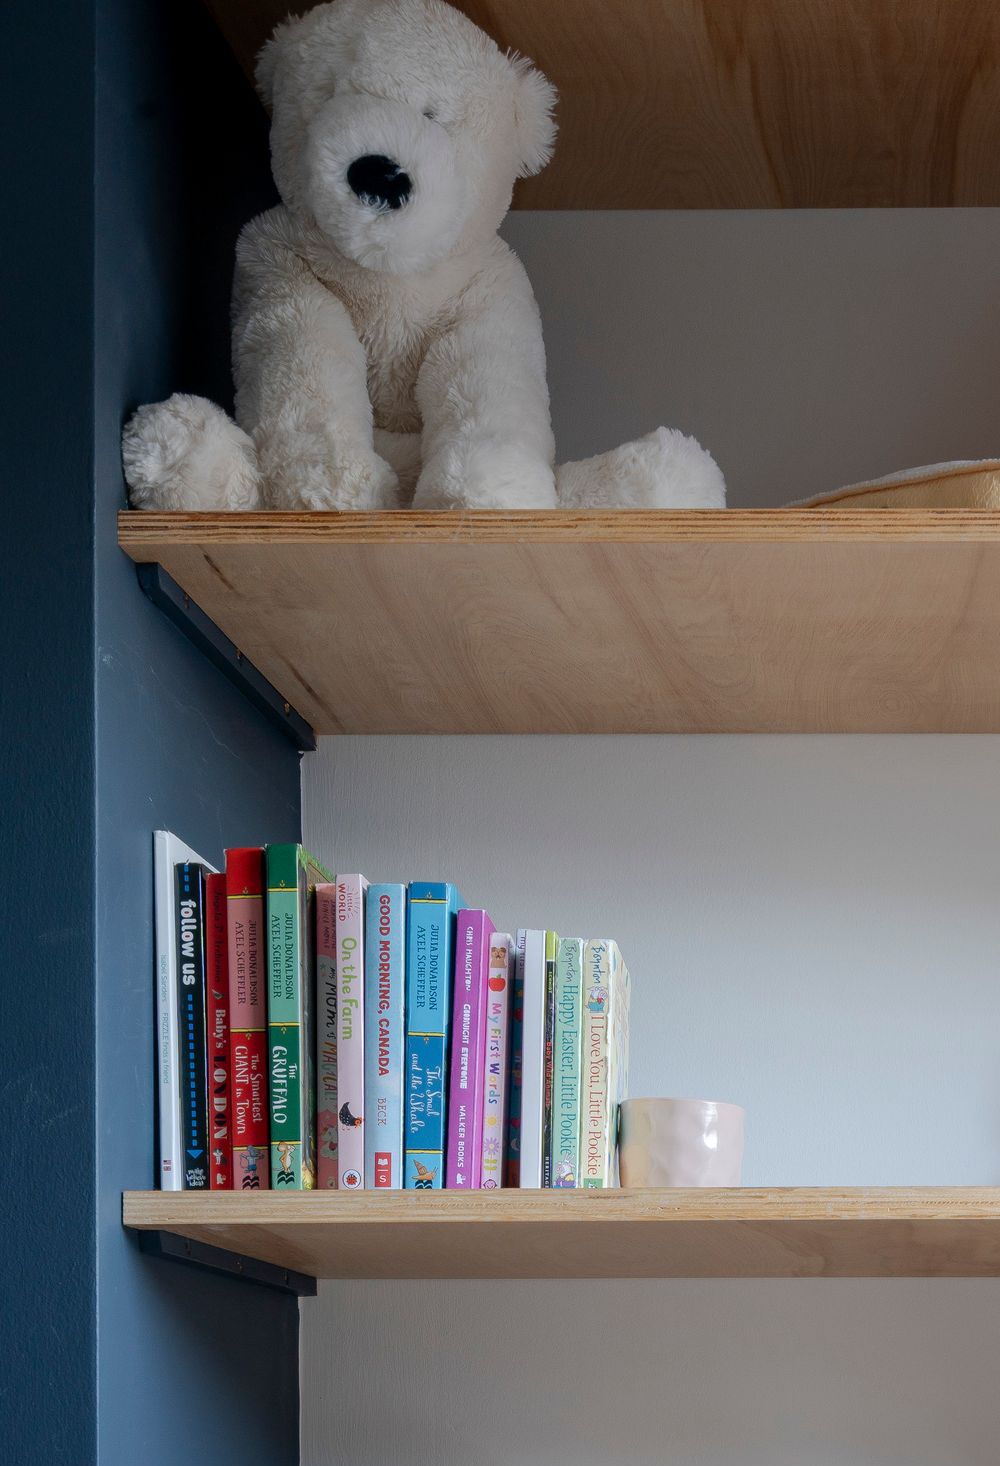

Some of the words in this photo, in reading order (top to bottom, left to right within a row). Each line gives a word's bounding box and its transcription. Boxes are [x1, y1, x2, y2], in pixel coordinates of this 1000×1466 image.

[338, 884, 346, 922] WORLD
[379, 895, 391, 936] GOOD
[180, 900, 196, 957] follow
[272, 915, 280, 940] AXEL
[284, 912, 293, 942] JULIA
[417, 926, 426, 953] AXEL
[431, 924, 439, 954] JULIA
[342, 938, 357, 961] On
[591, 945, 606, 984] Boynton
[182, 964, 196, 986] us
[272, 944, 282, 999] SCHEFFLER
[284, 942, 294, 1000] DONALDSON
[342, 966, 358, 994] the
[378, 940, 391, 1014] MORNING,
[416, 955, 426, 1008] SCHEFFLER
[429, 954, 439, 1011] DONALDSON
[488, 1003, 502, 1023] My
[559, 985, 578, 1027] Happy
[213, 1010, 227, 1048] Baby's
[378, 1018, 390, 1076] CANADA
[490, 1028, 502, 1057] First
[590, 1026, 604, 1057] Love
[235, 1046, 248, 1084] GIANT
[250, 1054, 260, 1070] The
[412, 1054, 422, 1070] and
[560, 1030, 578, 1072] Easter,
[272, 1046, 288, 1123] GRUFFALO
[412, 1073, 423, 1089] the
[425, 1066, 442, 1087] The
[488, 1063, 500, 1104] Words
[589, 1058, 604, 1088] You,
[214, 1056, 228, 1140] LONDON
[236, 1088, 244, 1098] in
[250, 1074, 264, 1122] Smartest
[427, 1090, 442, 1117] Snail
[560, 1077, 576, 1110] Little
[588, 1092, 603, 1127] Little
[236, 1098, 250, 1134] Town
[378, 1098, 386, 1126] BECK
[410, 1093, 426, 1134] Whale
[458, 1105, 466, 1138] WALKER
[560, 1114, 576, 1156] Pookie
[588, 1132, 602, 1175] Pookie
